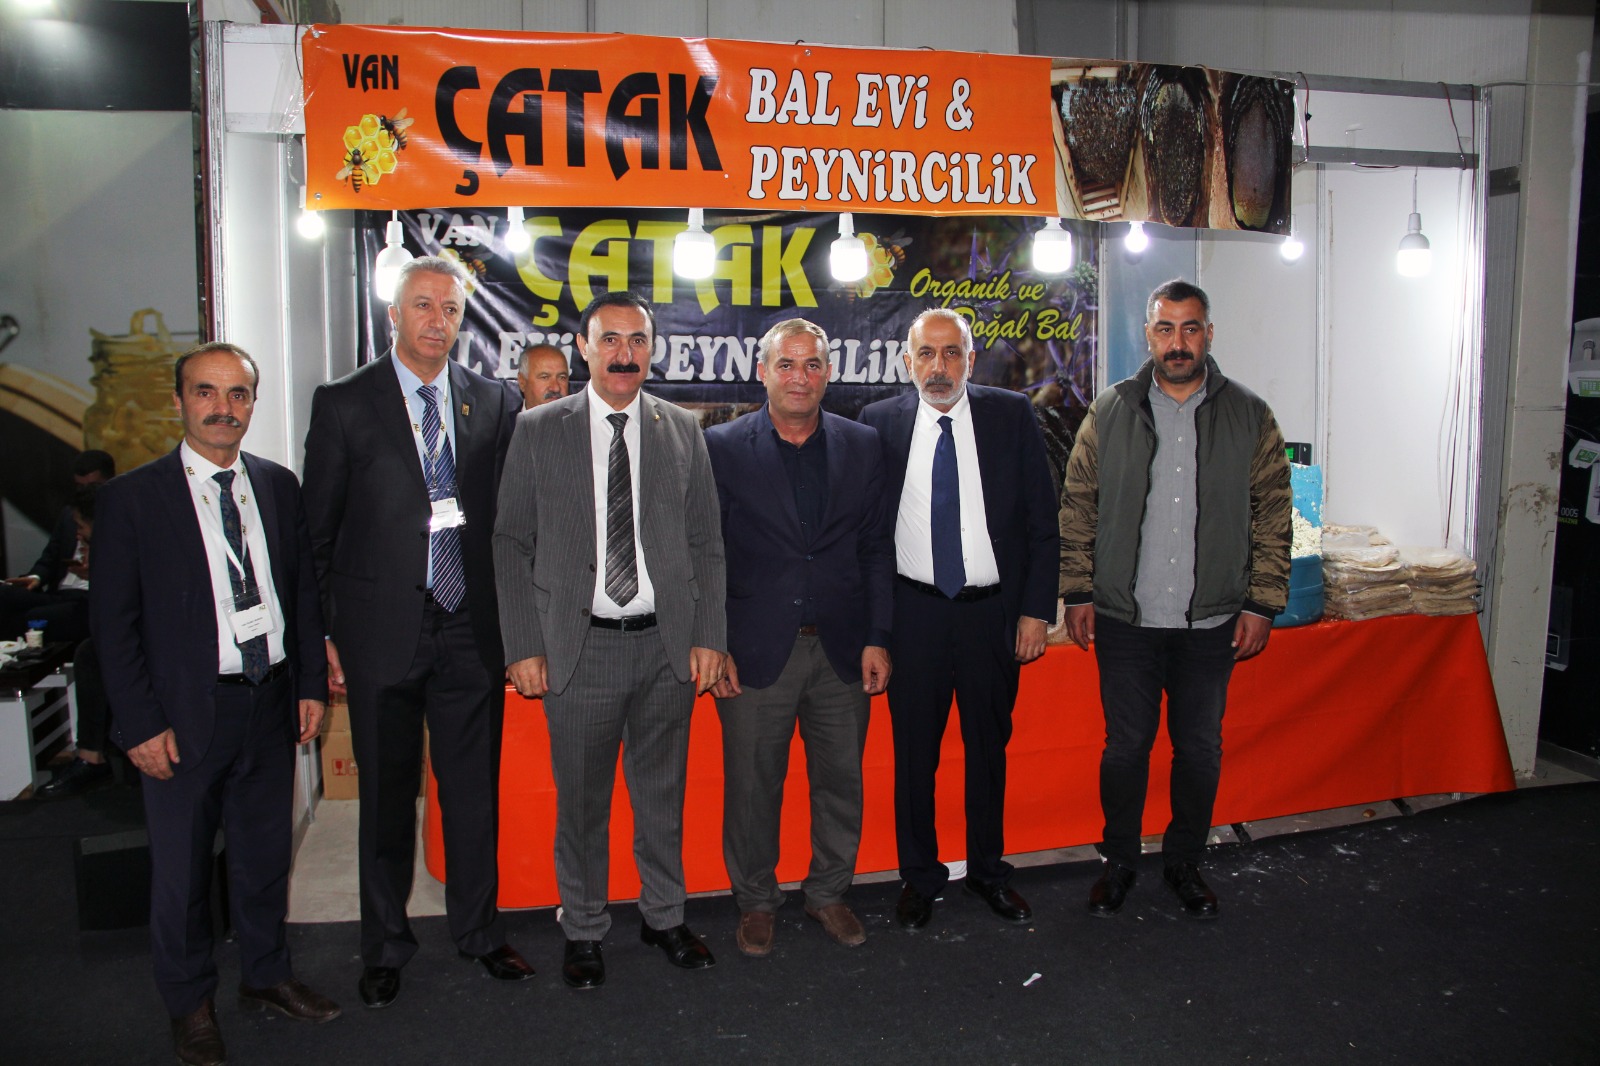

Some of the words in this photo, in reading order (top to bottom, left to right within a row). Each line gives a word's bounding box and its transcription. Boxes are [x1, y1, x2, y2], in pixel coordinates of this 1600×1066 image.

[342, 53, 399, 93] VAN
[745, 67, 839, 128] BAL
[944, 77, 974, 132] &
[434, 65, 723, 196] ÇATAK
[417, 212, 499, 247] VAN
[513, 215, 819, 327] ÇATAK
[910, 267, 1011, 309] Organik
[1018, 282, 1046, 301] ve
[1036, 309, 1083, 341] Bal
